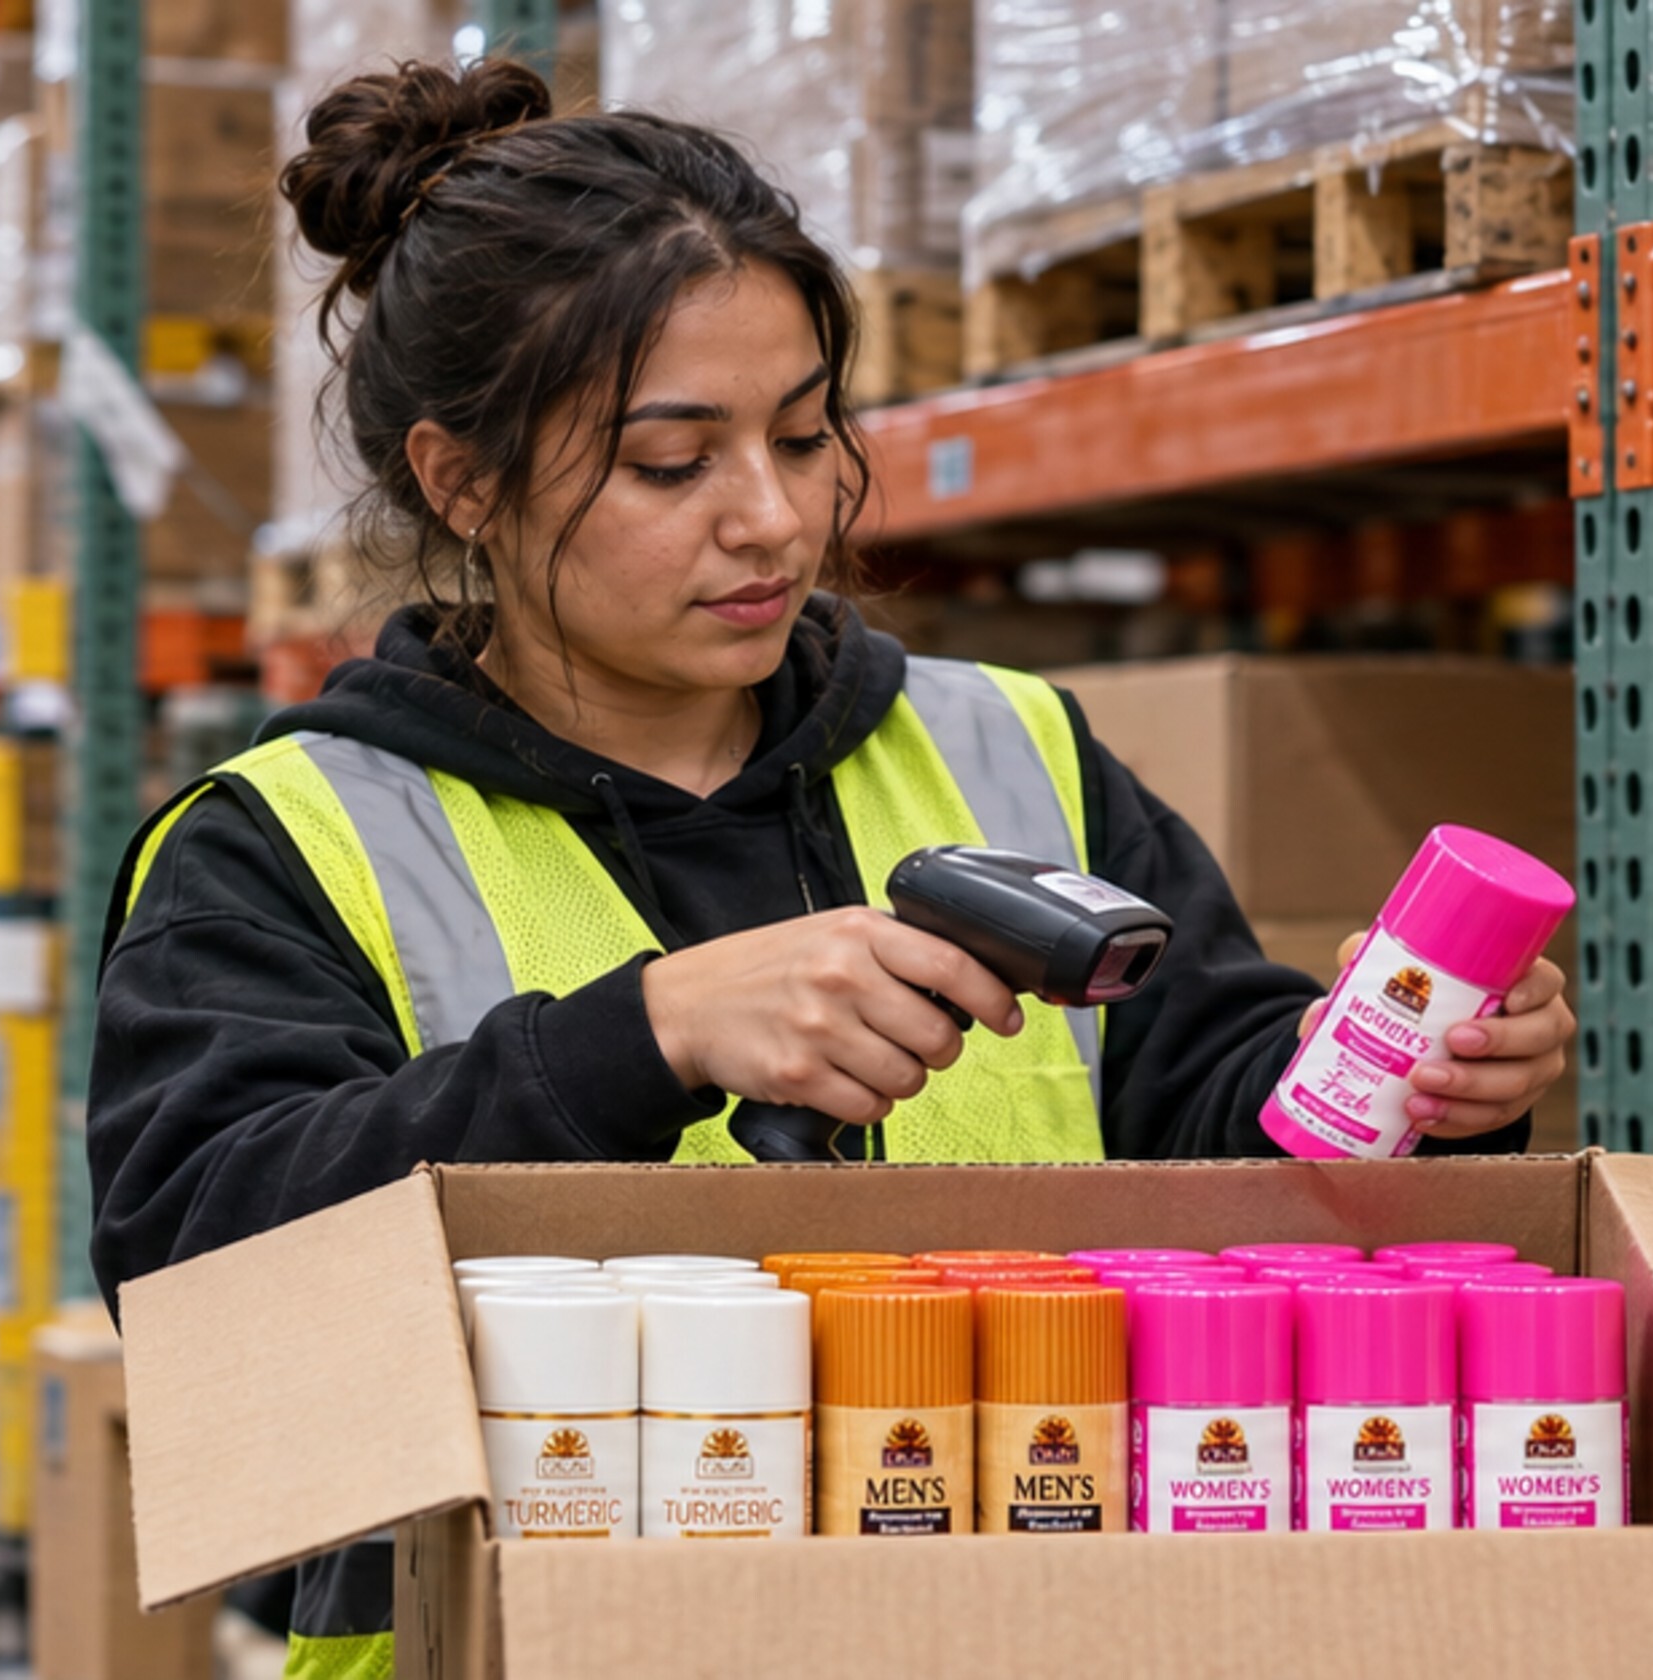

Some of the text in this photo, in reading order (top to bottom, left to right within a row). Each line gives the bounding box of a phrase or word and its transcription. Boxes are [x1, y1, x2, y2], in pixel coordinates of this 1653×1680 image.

[865, 1476, 946, 1505] MEN'S
[1014, 1473, 1095, 1500] MEN'S
[1170, 1479, 1272, 1499] WOMEN'S
[1327, 1477, 1431, 1499] WOMEN'S
[1498, 1474, 1601, 1496] WOMEN'S
[504, 1498, 622, 1526] TURMERIC
[663, 1498, 783, 1526] TURMERIC
